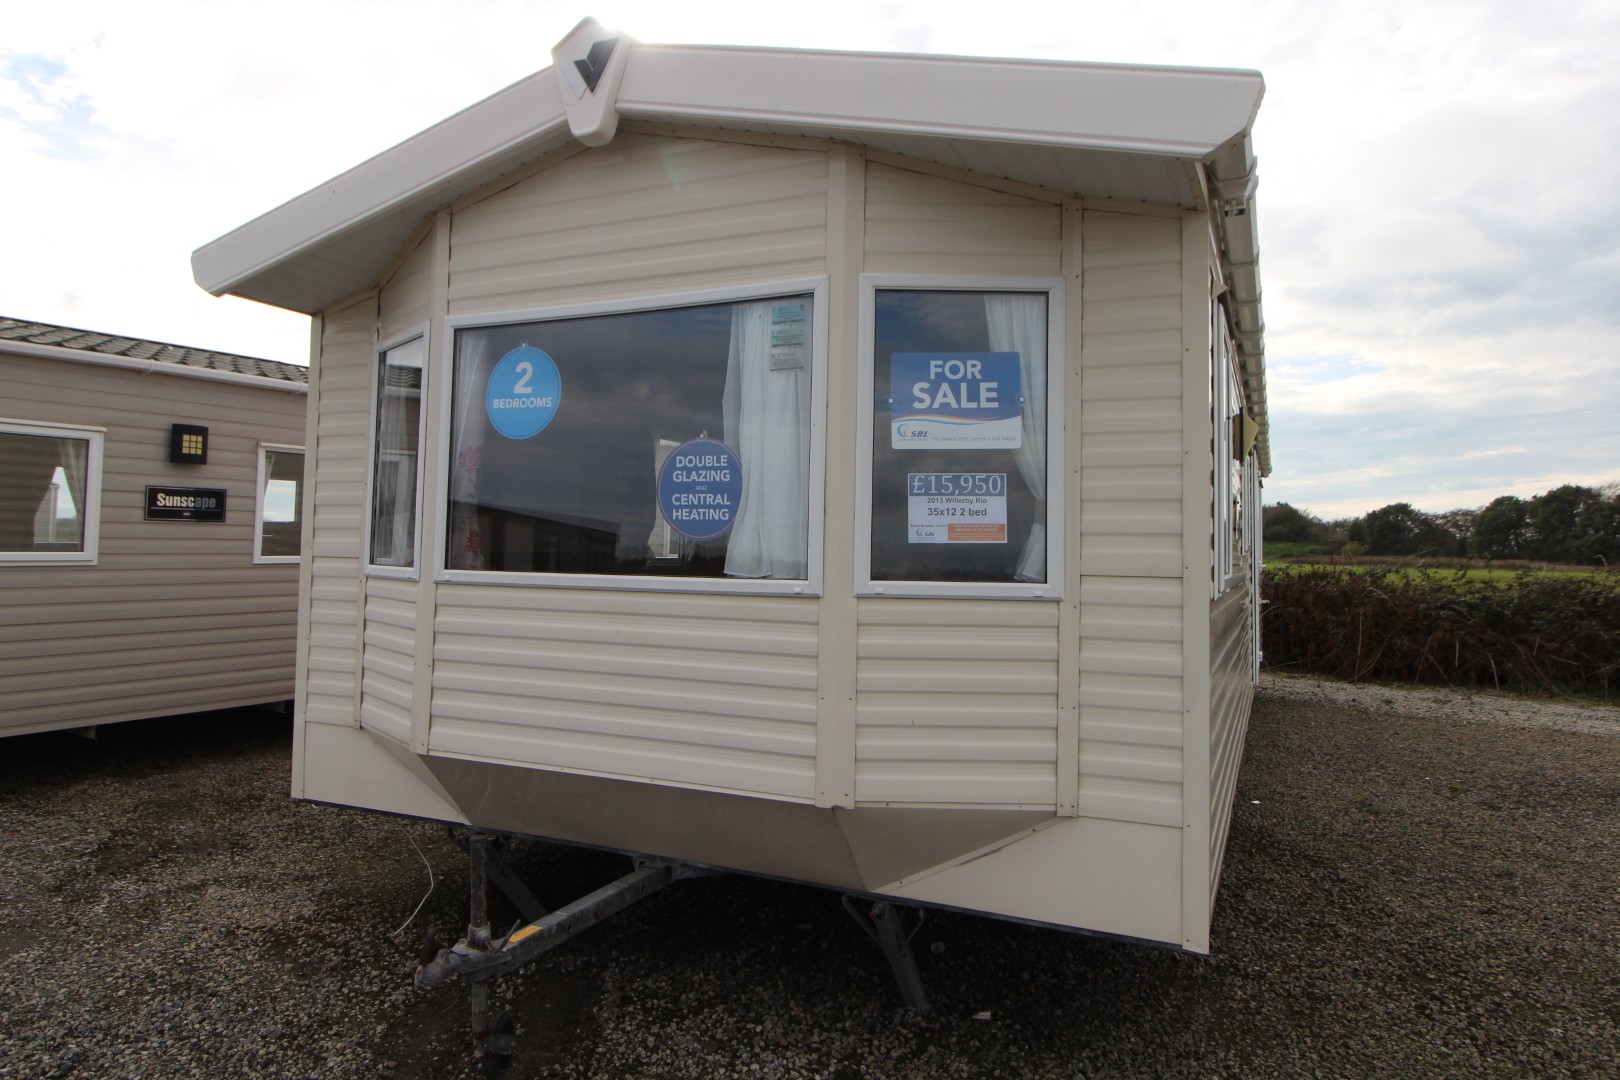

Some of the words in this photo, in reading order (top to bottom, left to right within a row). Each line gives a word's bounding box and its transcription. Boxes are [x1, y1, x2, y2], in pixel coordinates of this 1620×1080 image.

[930, 360, 982, 380] FOR
[513, 361, 533, 394] 2
[912, 382, 999, 409] SALE
[493, 397, 552, 409] BEDROOMS
[910, 430, 929, 438] SBL
[676, 455, 728, 467] DOUBLE
[672, 470, 730, 482] GLAZING
[912, 475, 1001, 496] £15,950
[156, 493, 216, 510] Sunscape
[671, 493, 731, 506] CENTRAL
[945, 497, 974, 505] Willerby
[672, 508, 729, 520] HEATING
[927, 507, 957, 516] 35x12
[959, 507, 966, 516] 2
[968, 507, 987, 516] bed
